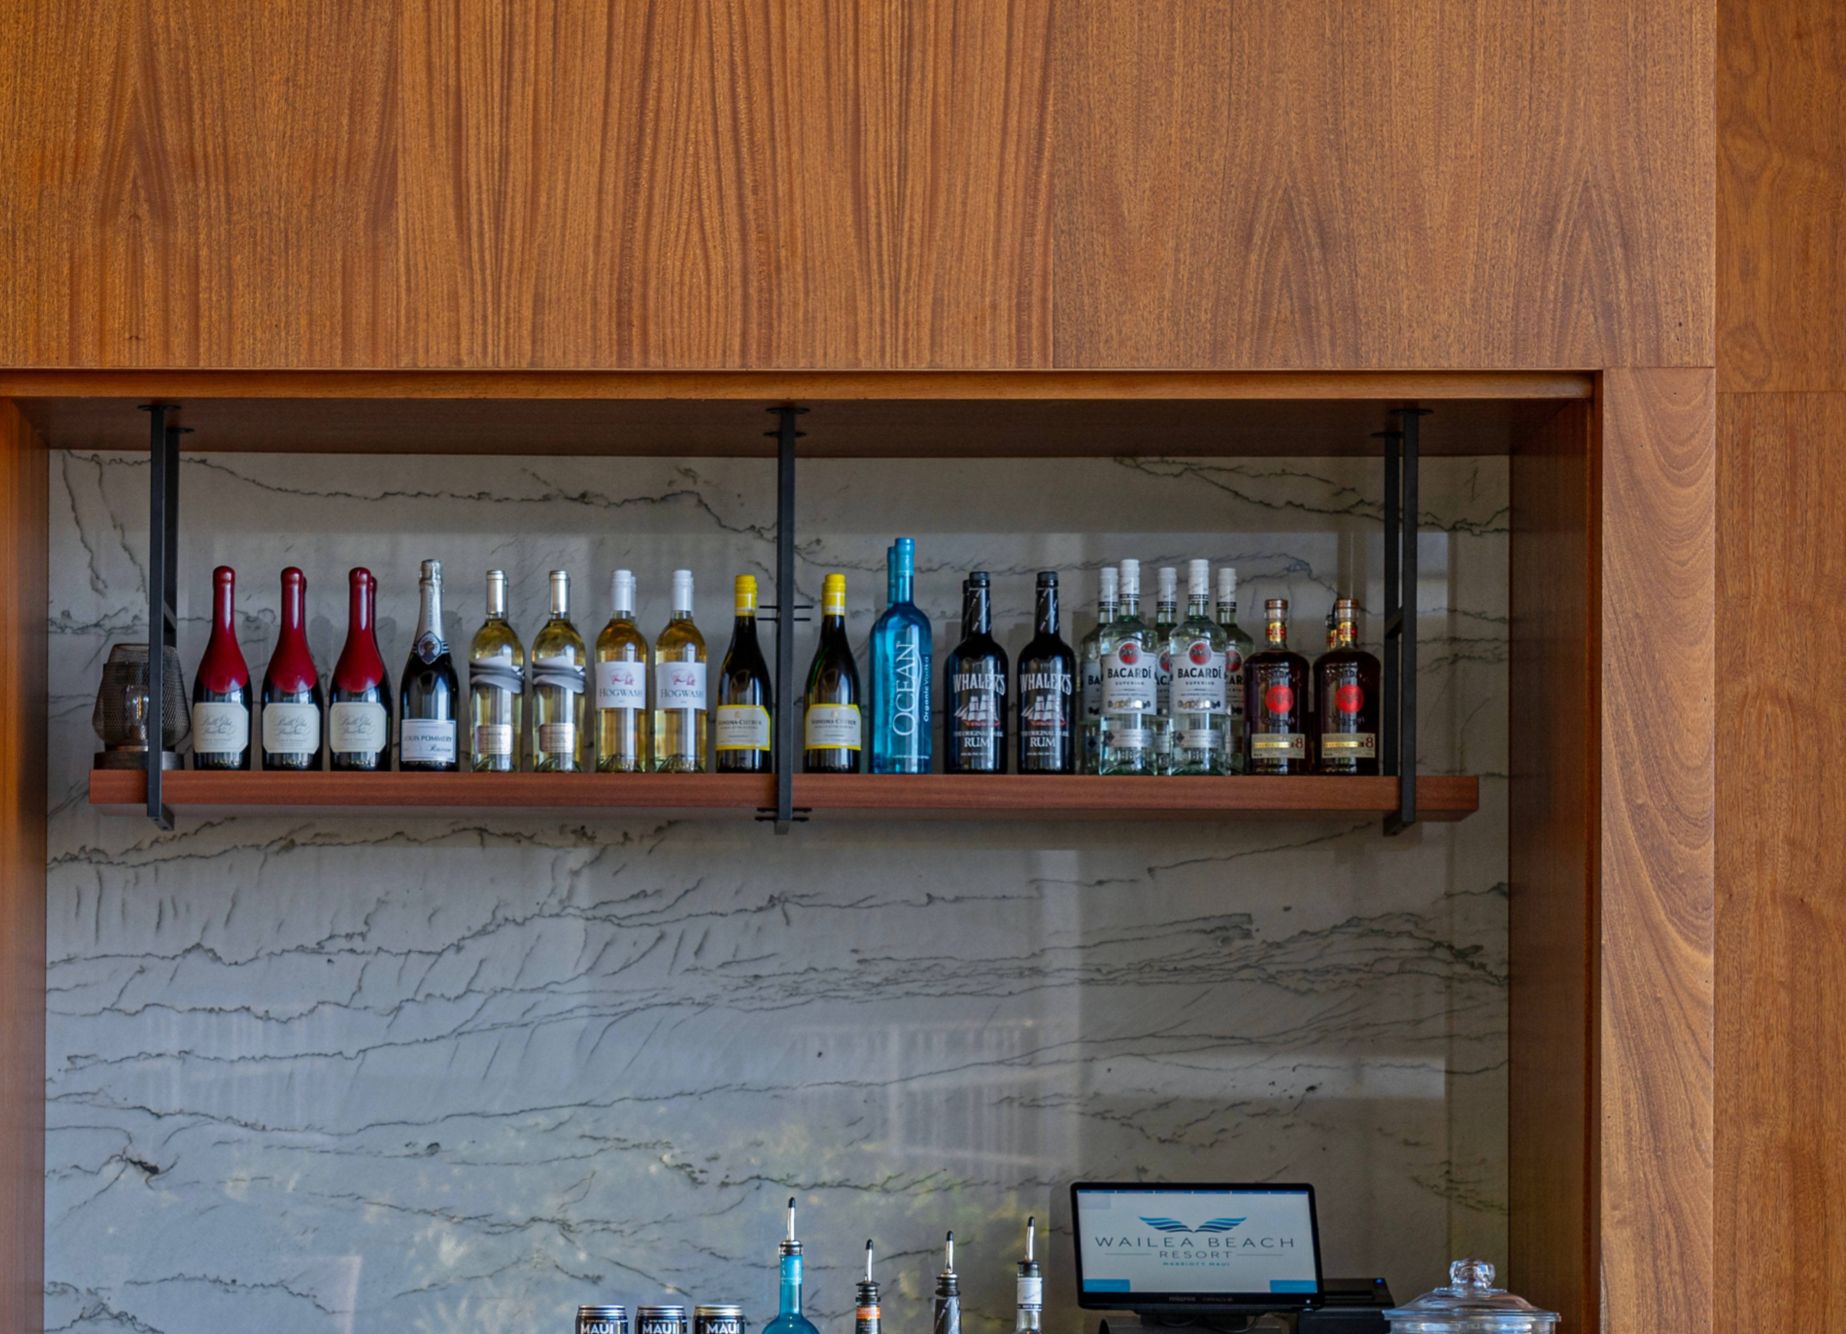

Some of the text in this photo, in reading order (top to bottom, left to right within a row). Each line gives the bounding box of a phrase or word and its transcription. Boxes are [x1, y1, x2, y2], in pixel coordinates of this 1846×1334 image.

[1107, 665, 1152, 679] BACARDÍ
[1177, 665, 1223, 679] BACARDÍ
[893, 644, 916, 736] OCEAN
[963, 737, 992, 748] RUM
[1029, 737, 1057, 748] RUM
[1295, 738, 1304, 749] 8
[1365, 737, 1374, 748] 8
[1095, 1236, 1295, 1249] WAILEA BEACH
[1159, 1250, 1233, 1259] RESORT
[580, 1323, 614, 1334] MAUI
[642, 1323, 677, 1334] MAUI
[706, 1323, 740, 1334] MAUI
